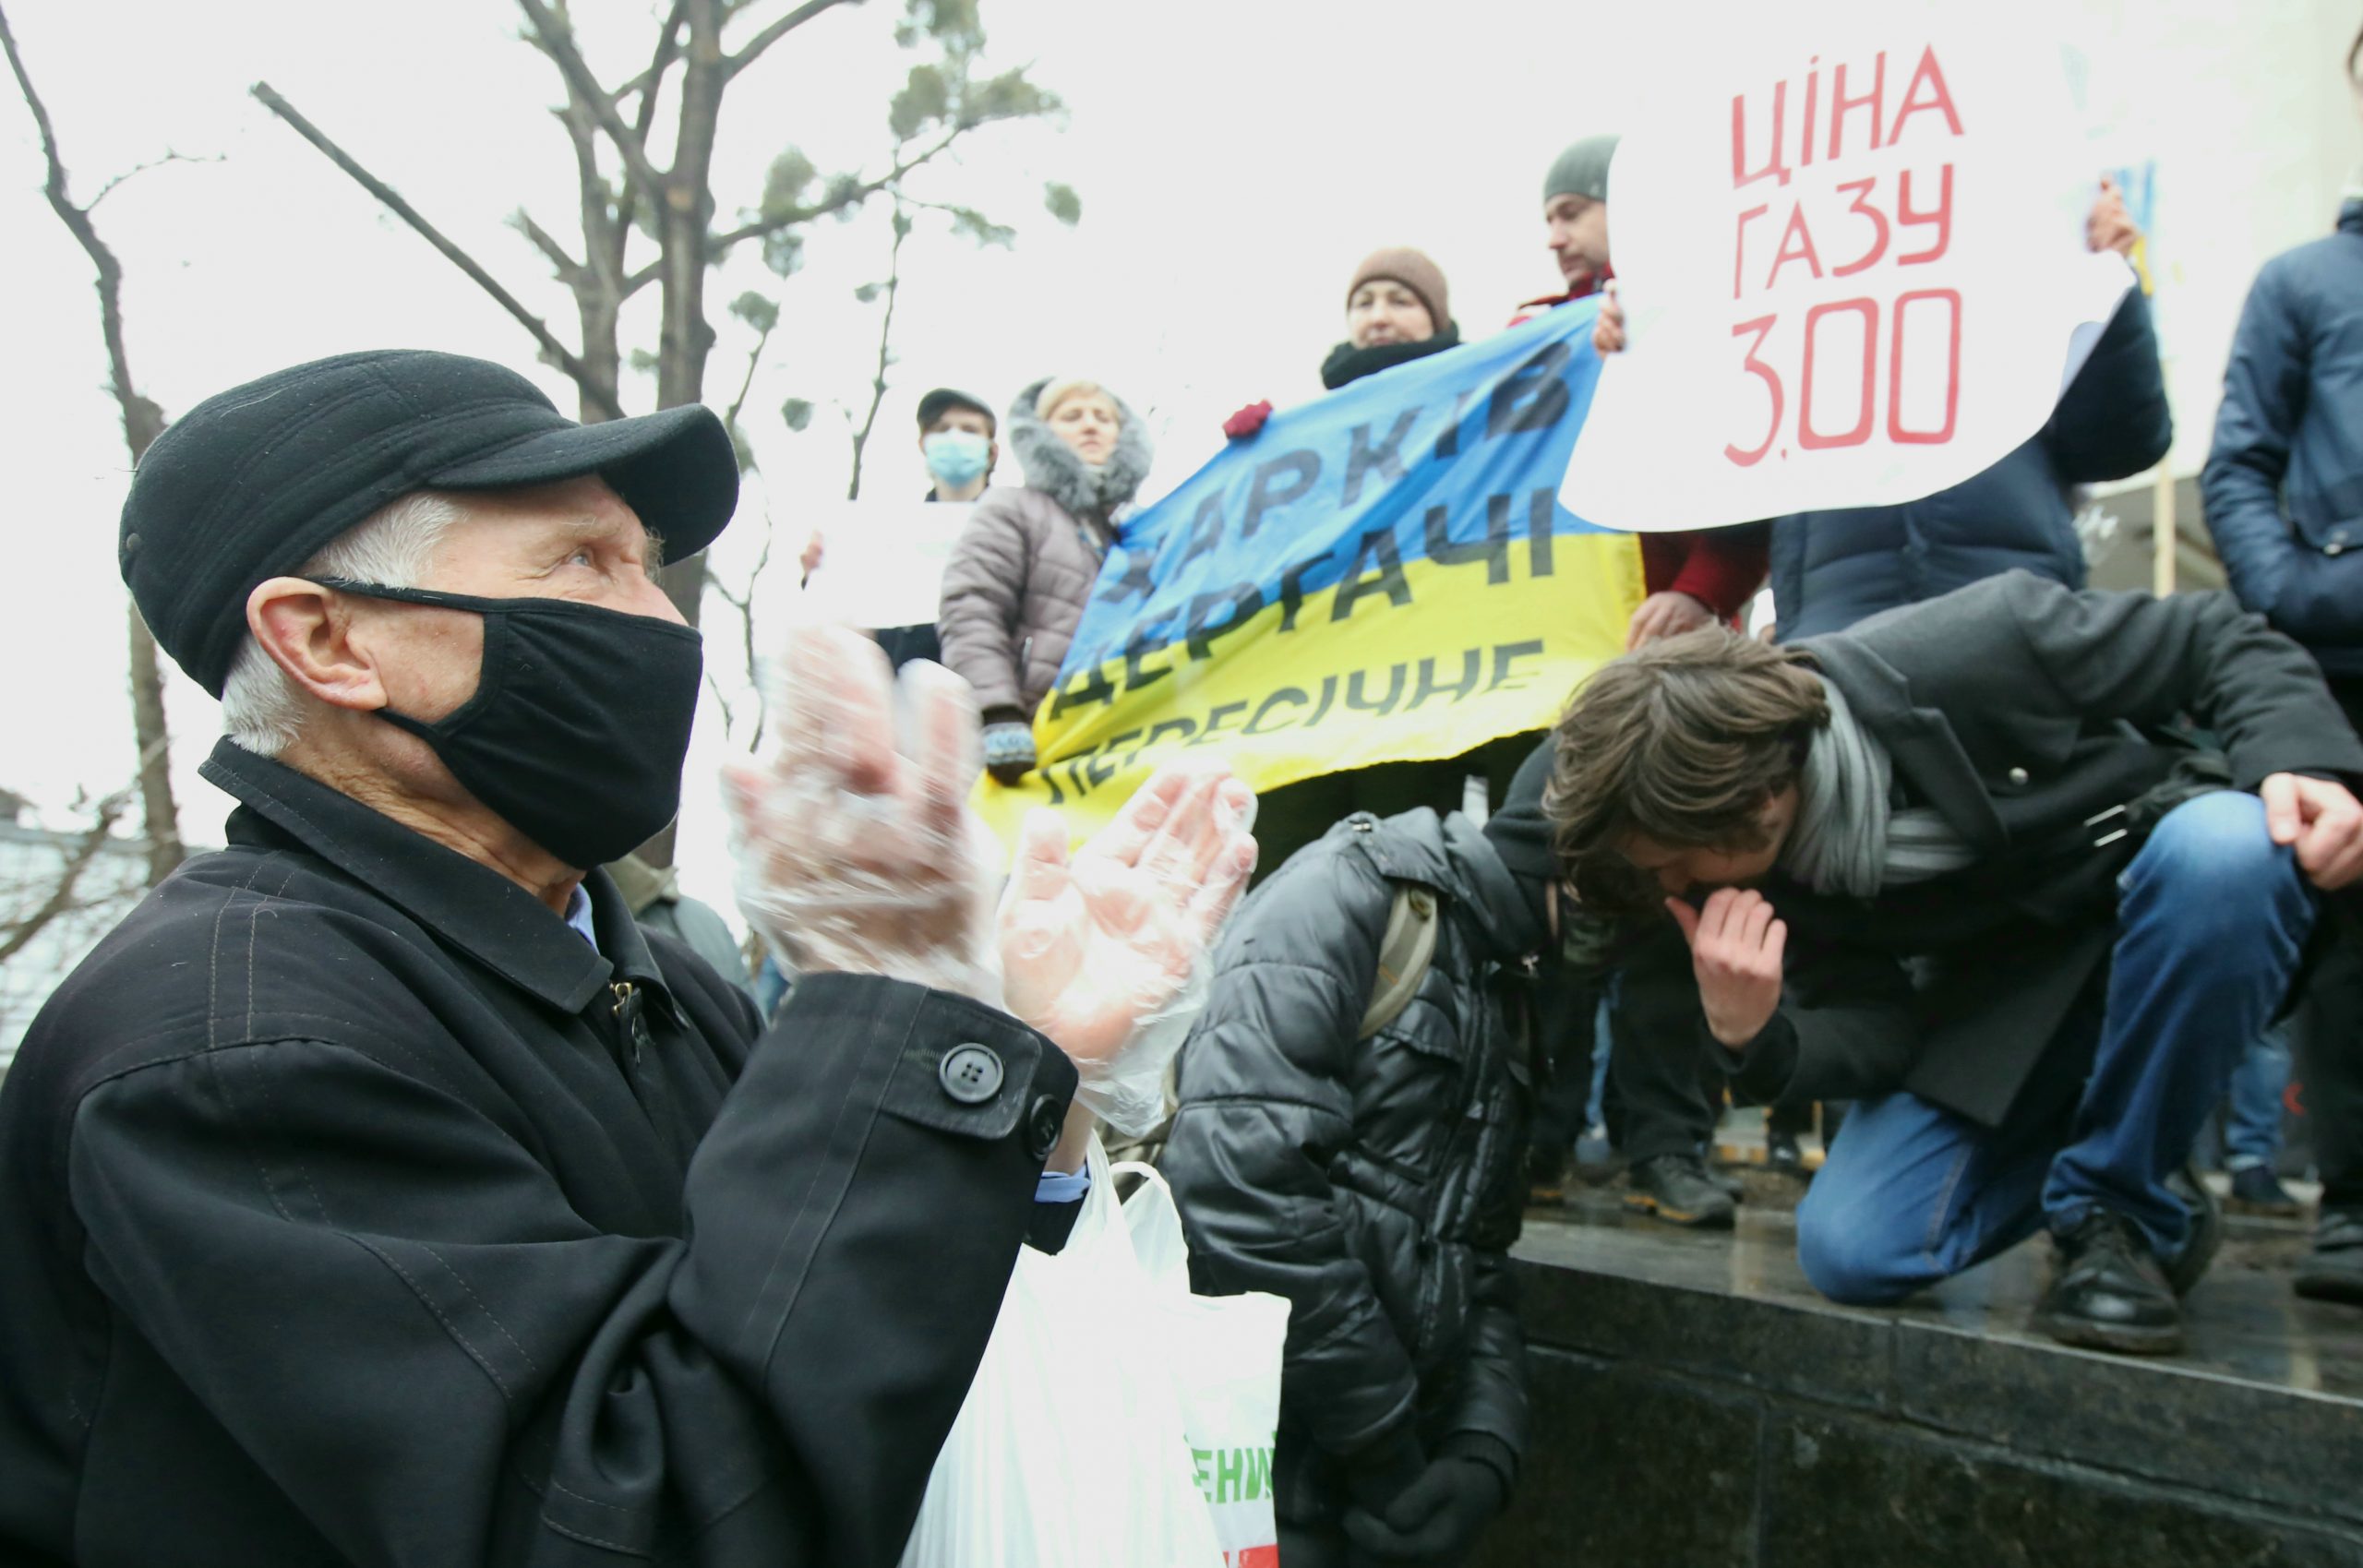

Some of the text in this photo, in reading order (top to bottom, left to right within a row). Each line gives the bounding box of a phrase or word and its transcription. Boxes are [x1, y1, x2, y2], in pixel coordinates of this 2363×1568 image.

[1733, 162, 1954, 299] ГАЗУ
[1049, 487, 1554, 722] ДЕРГАЧІ
[1040, 640, 1543, 805] ПЕРЕСІЧНЕ
